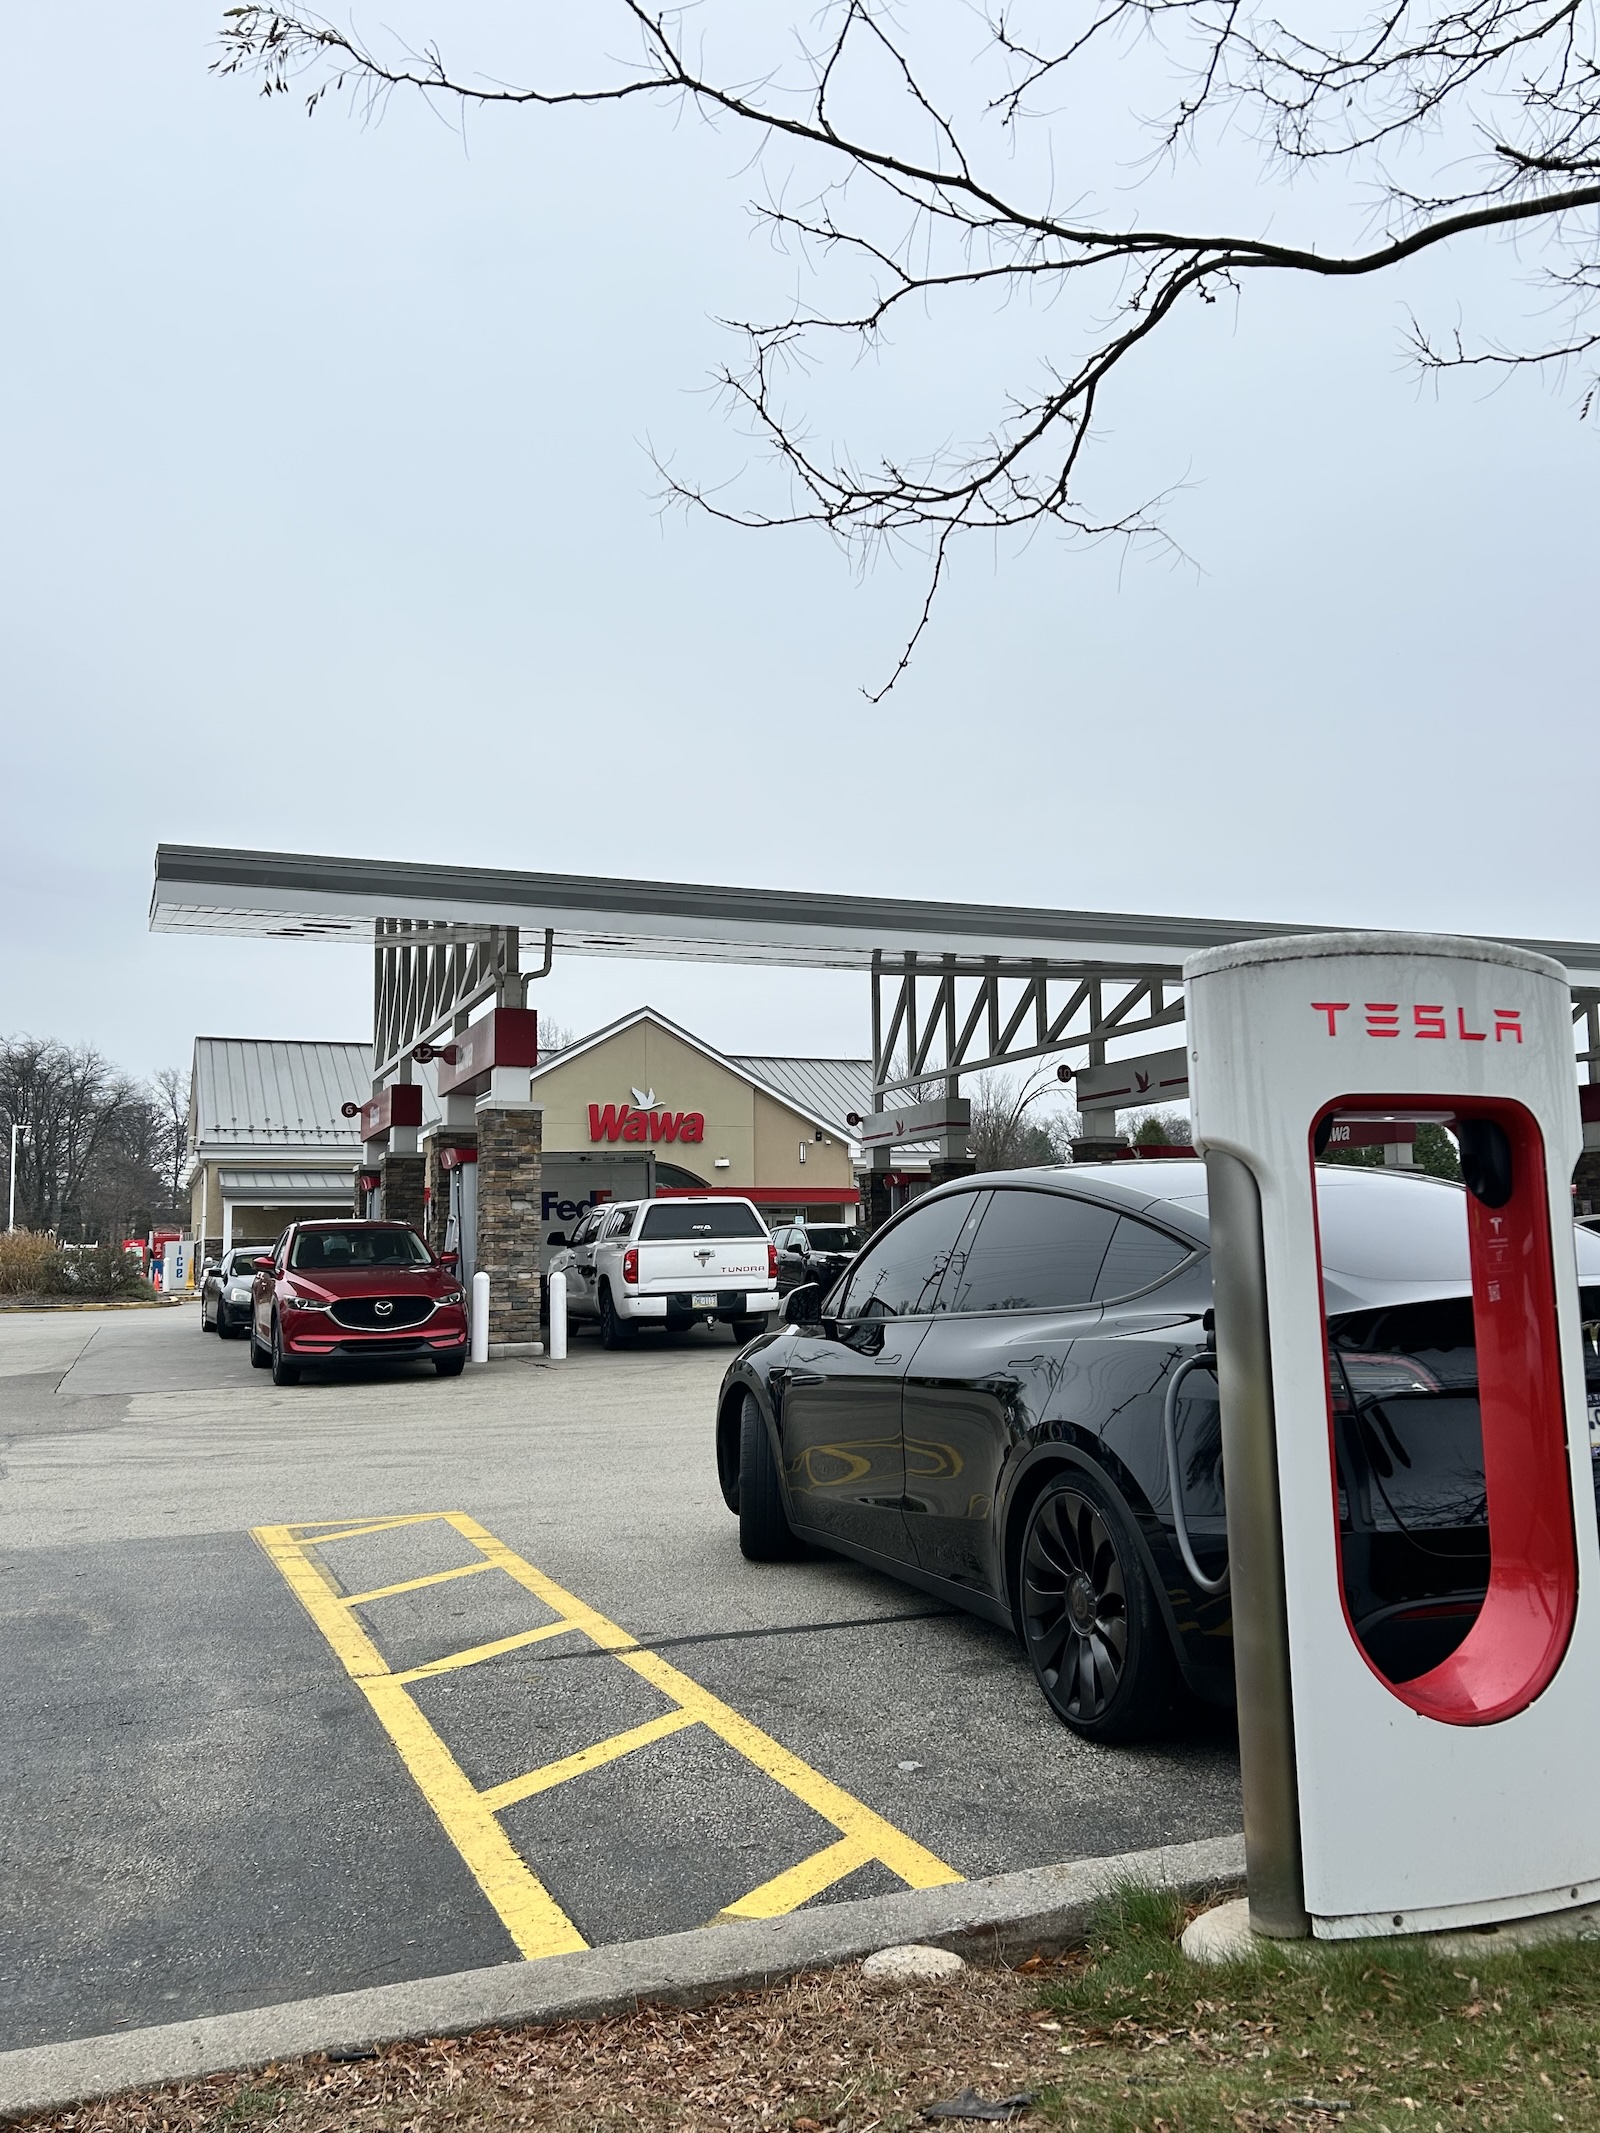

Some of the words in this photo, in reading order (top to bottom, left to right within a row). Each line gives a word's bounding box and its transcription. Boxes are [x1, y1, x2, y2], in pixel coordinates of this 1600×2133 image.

[1310, 1002, 1523, 1043] TESLA
[414, 1047, 432, 1060] 12
[1058, 1068, 1071, 1079] 10
[345, 1105, 354, 1115] 6
[588, 1103, 705, 1143] Wawa
[1329, 1125, 1351, 1142] wa
[541, 1190, 613, 1221] FedE
[720, 1265, 765, 1273] TUNDRA
